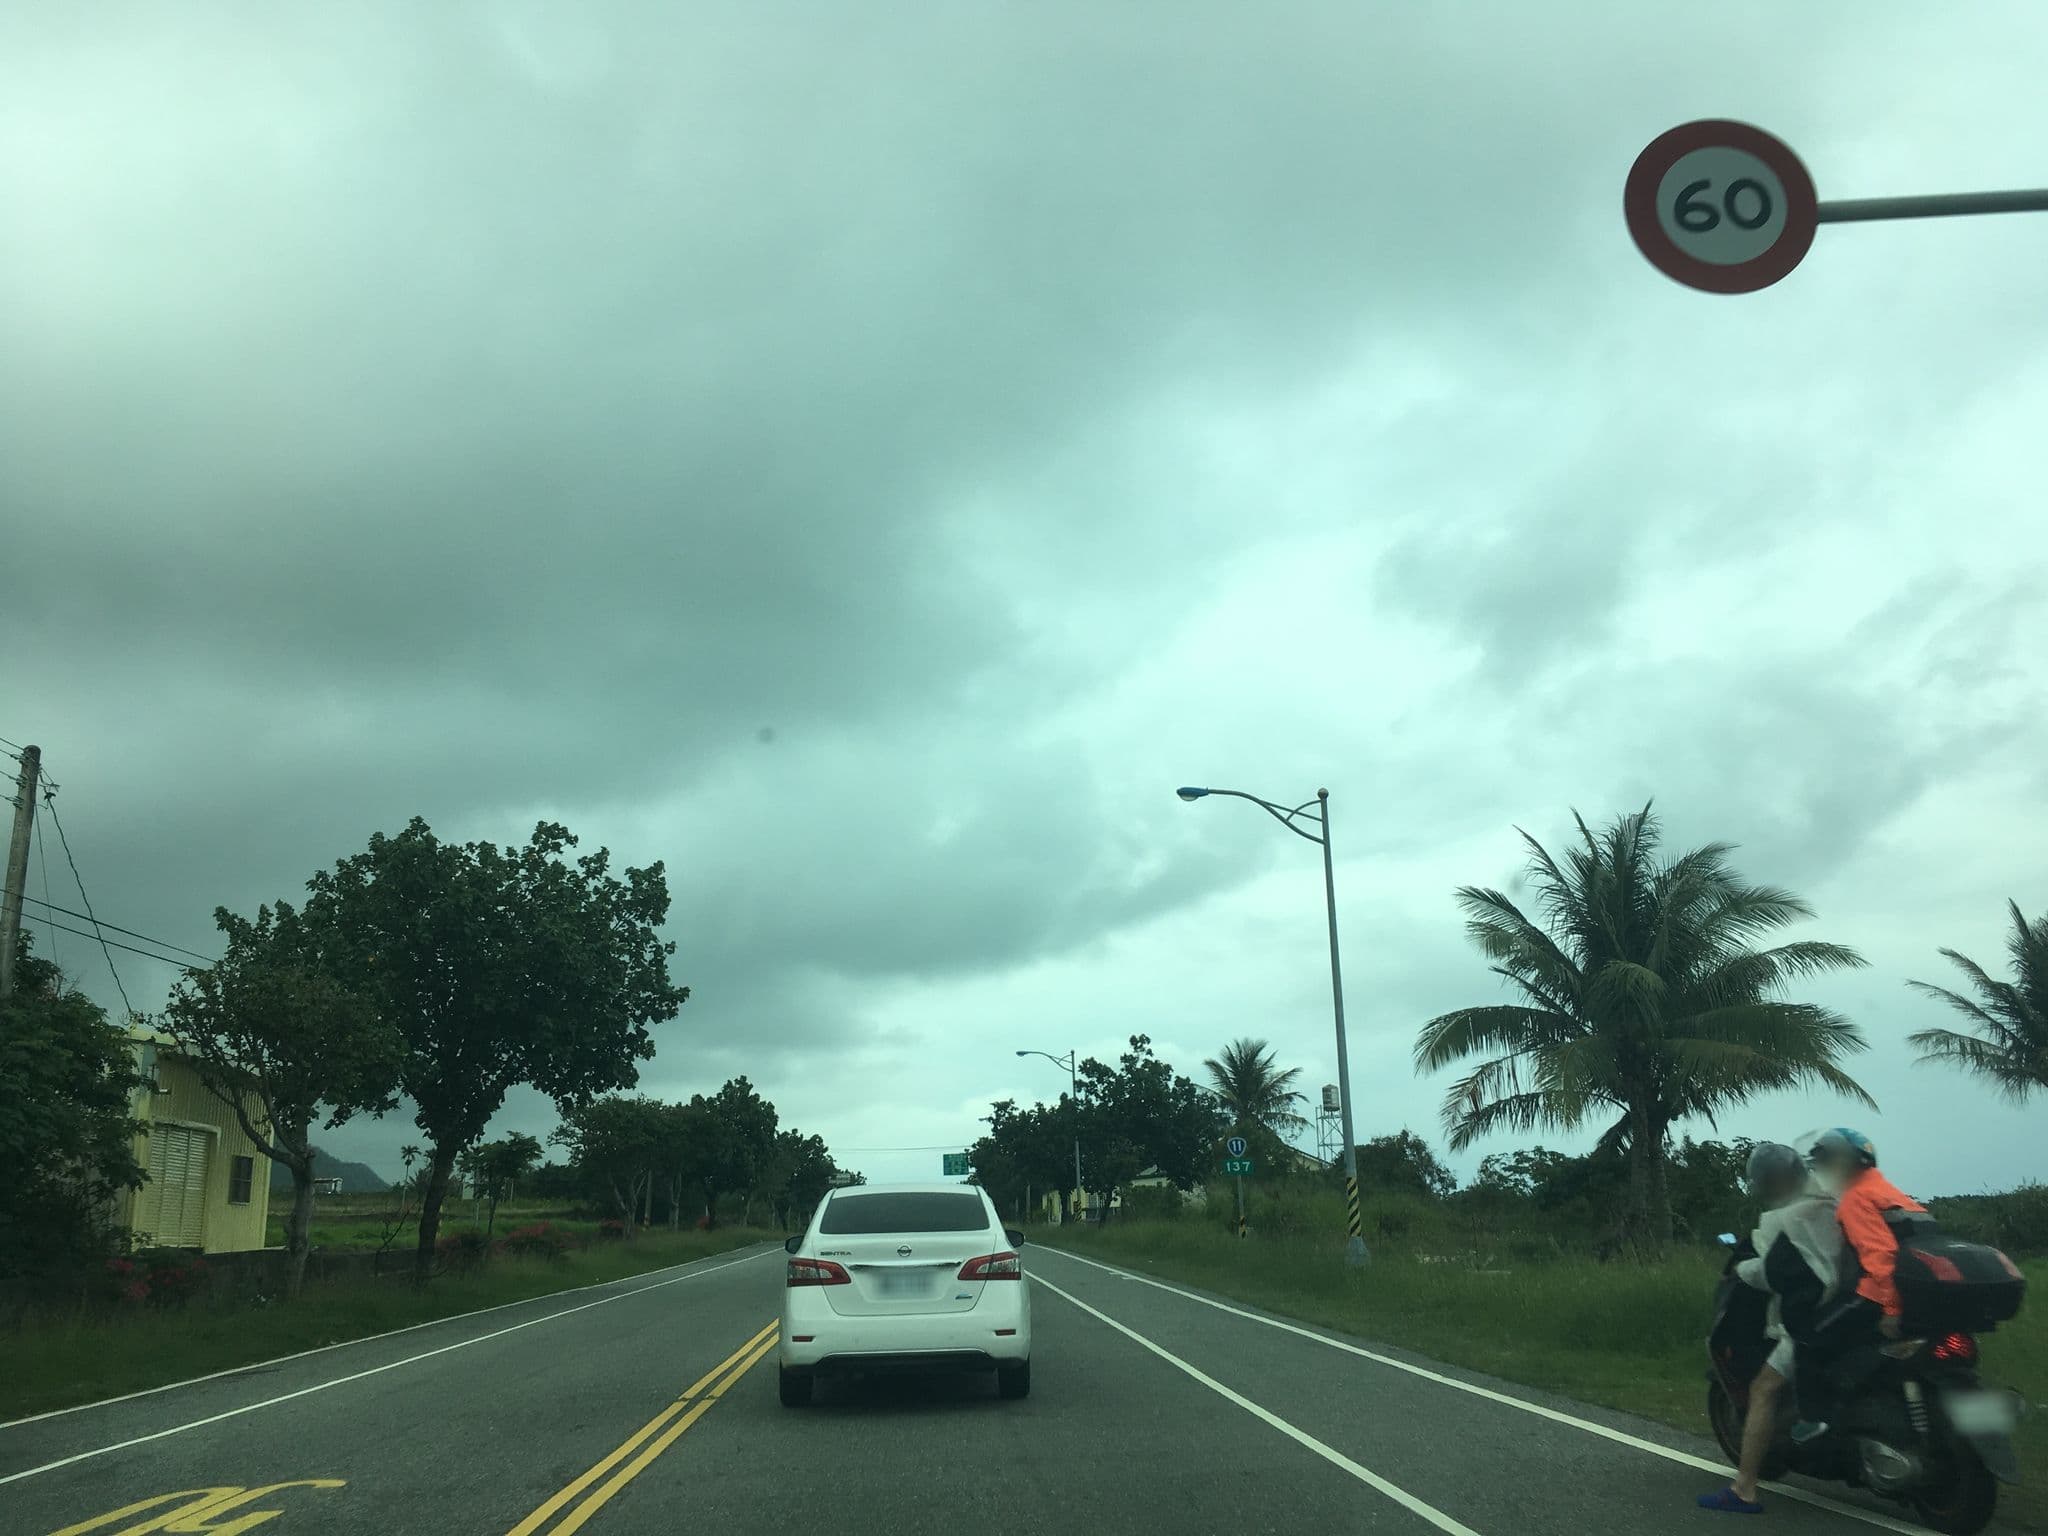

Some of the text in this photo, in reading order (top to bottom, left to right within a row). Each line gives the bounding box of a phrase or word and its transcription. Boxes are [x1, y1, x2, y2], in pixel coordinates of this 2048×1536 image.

[1673, 177, 1773, 233] 60
[1232, 1140, 1242, 1151] 11
[1226, 1161, 1251, 1172] 137
